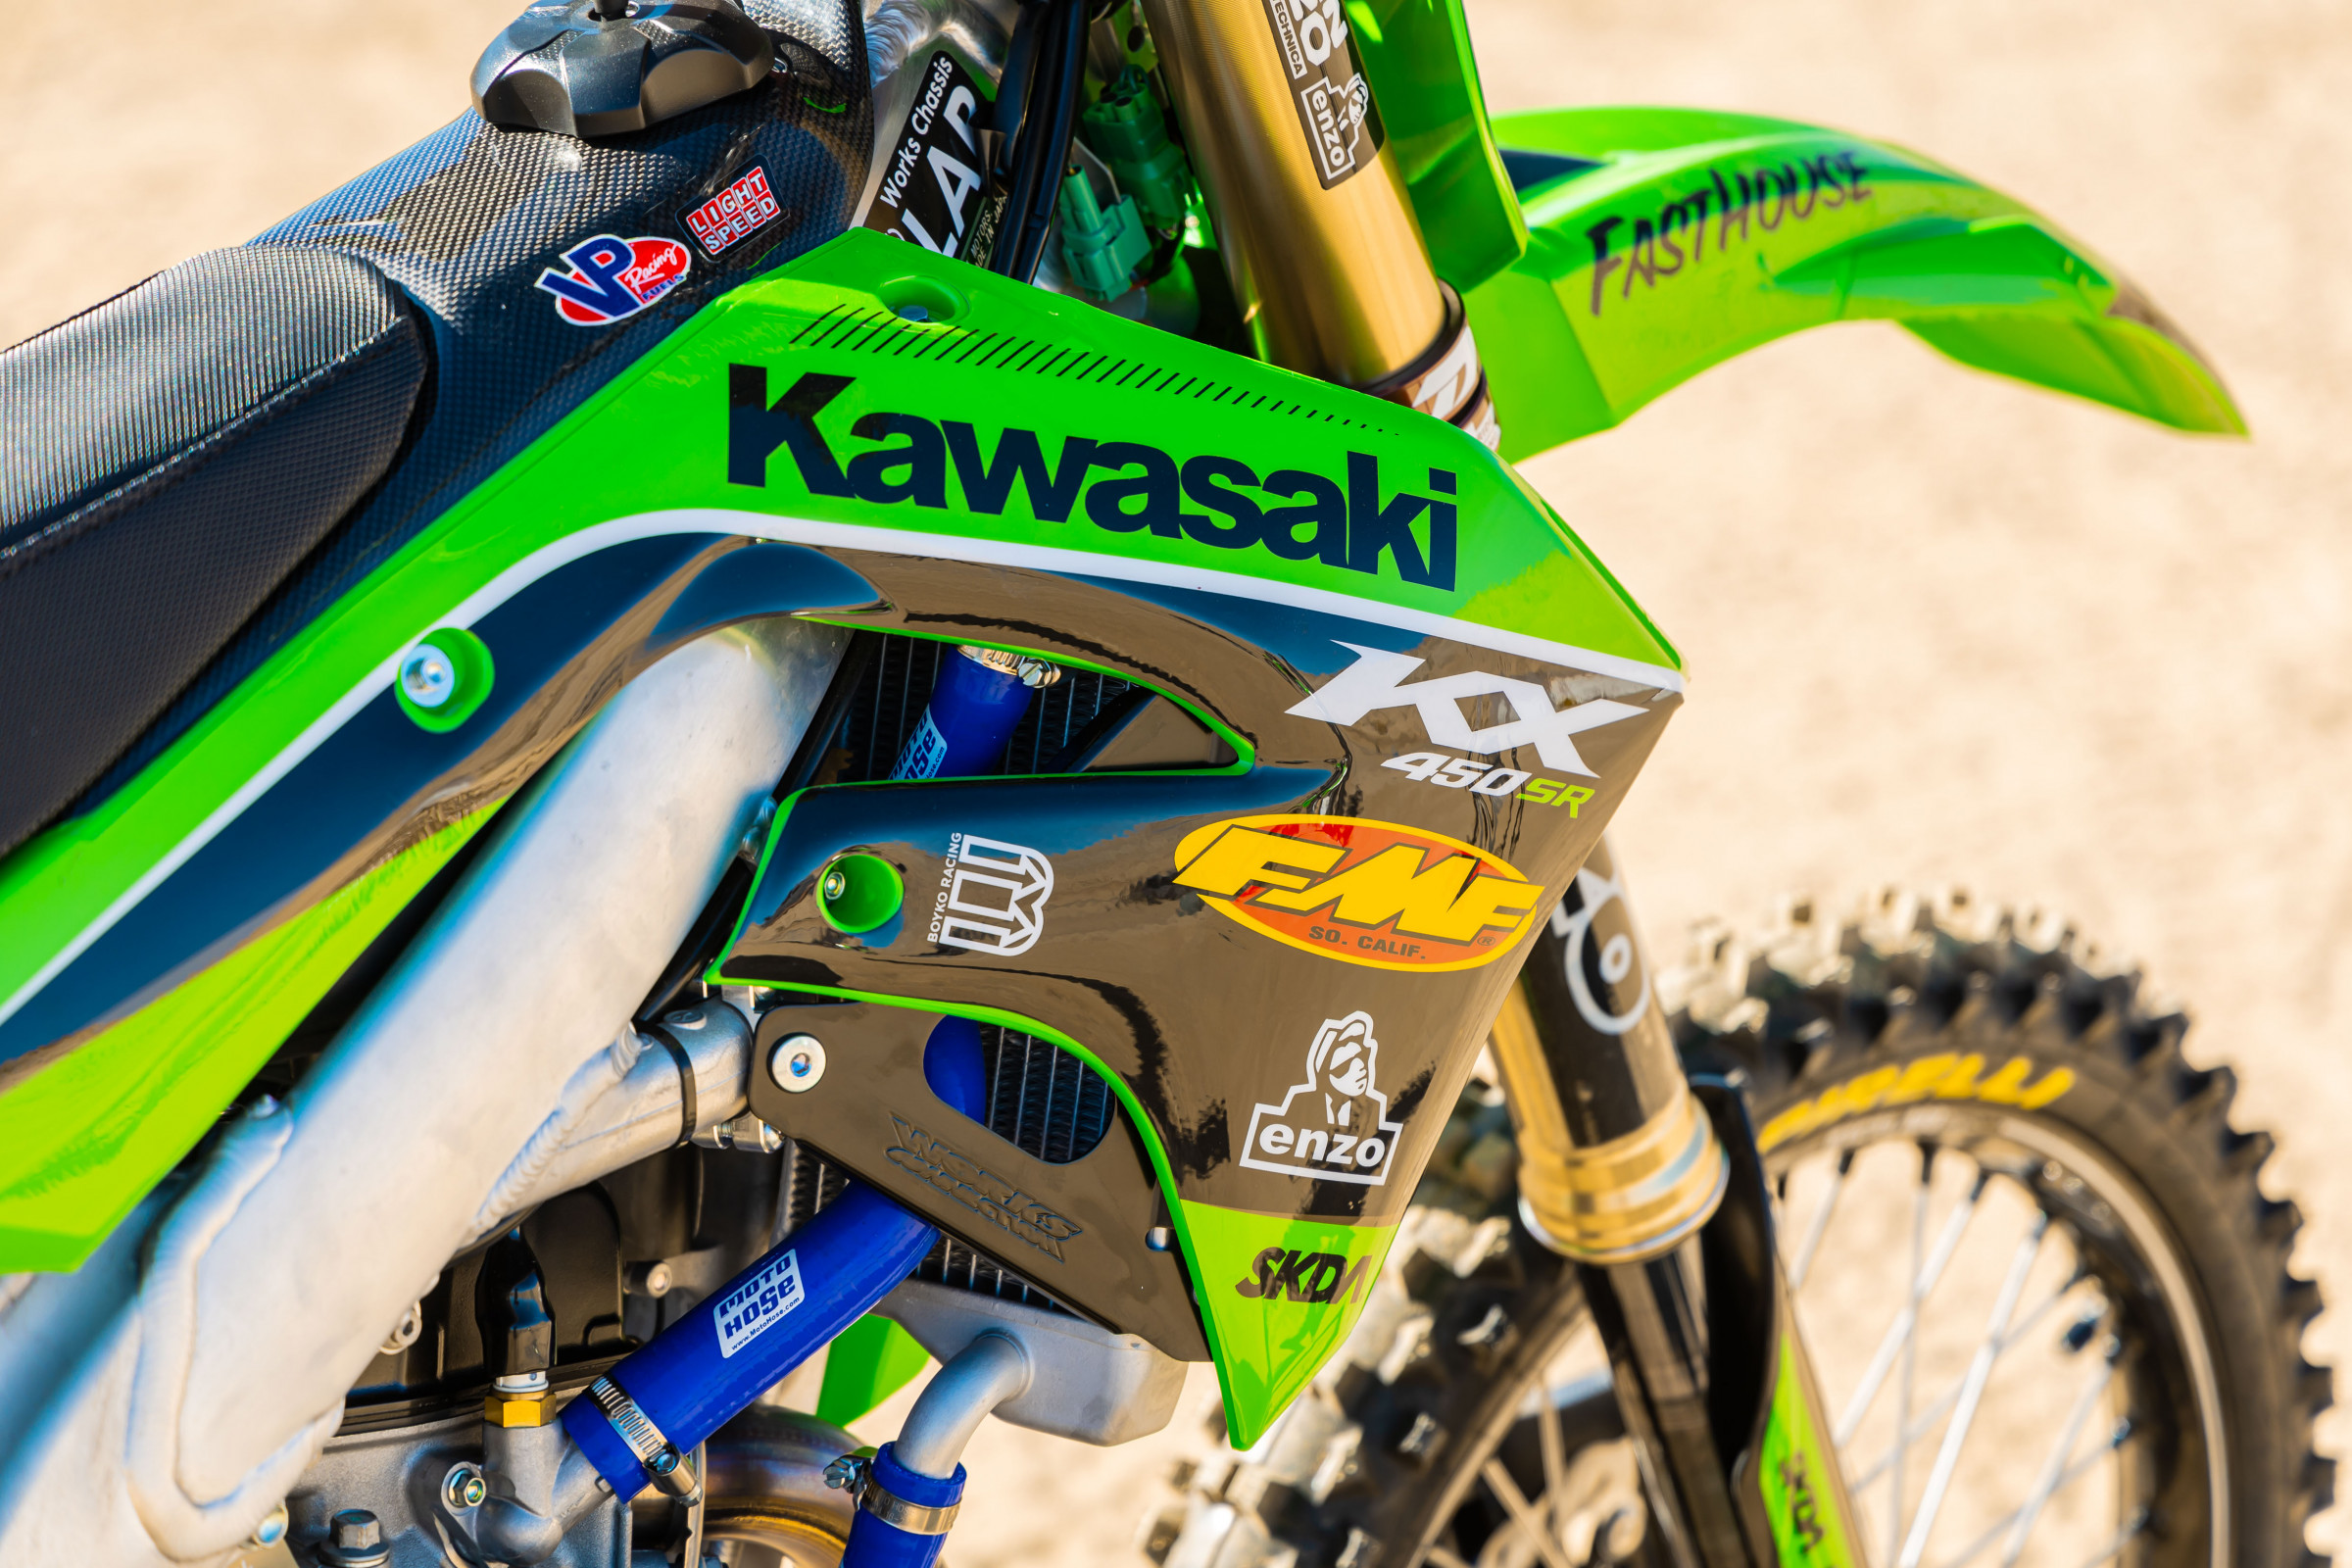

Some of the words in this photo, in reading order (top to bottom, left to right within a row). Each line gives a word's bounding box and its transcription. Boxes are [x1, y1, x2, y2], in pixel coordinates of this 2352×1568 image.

[1273, 0, 1304, 75] ECHNICA
[879, 137, 921, 209] Works
[910, 56, 954, 135] Chassis
[1311, 89, 1346, 167] enzo
[689, 171, 764, 234] LIGHT
[704, 197, 777, 252] SPEED
[1586, 150, 1873, 318] FASTHOUSE
[536, 236, 643, 318] VP
[624, 244, 678, 294] Racing
[641, 272, 685, 303] FUELS
[727, 363, 1457, 592] Kawasaki
[1284, 639, 1650, 778] KX
[926, 891, 949, 943] BOYKO
[940, 832, 962, 888] RACING
[1172, 823, 1545, 947] FMF
[1308, 924, 1349, 948] SO.
[1357, 935, 1427, 961] CALIF.
[1258, 1123, 1386, 1168] enzo
[718, 1254, 792, 1319] MOTO
[731, 1297, 801, 1350] www.MotoHose.com
